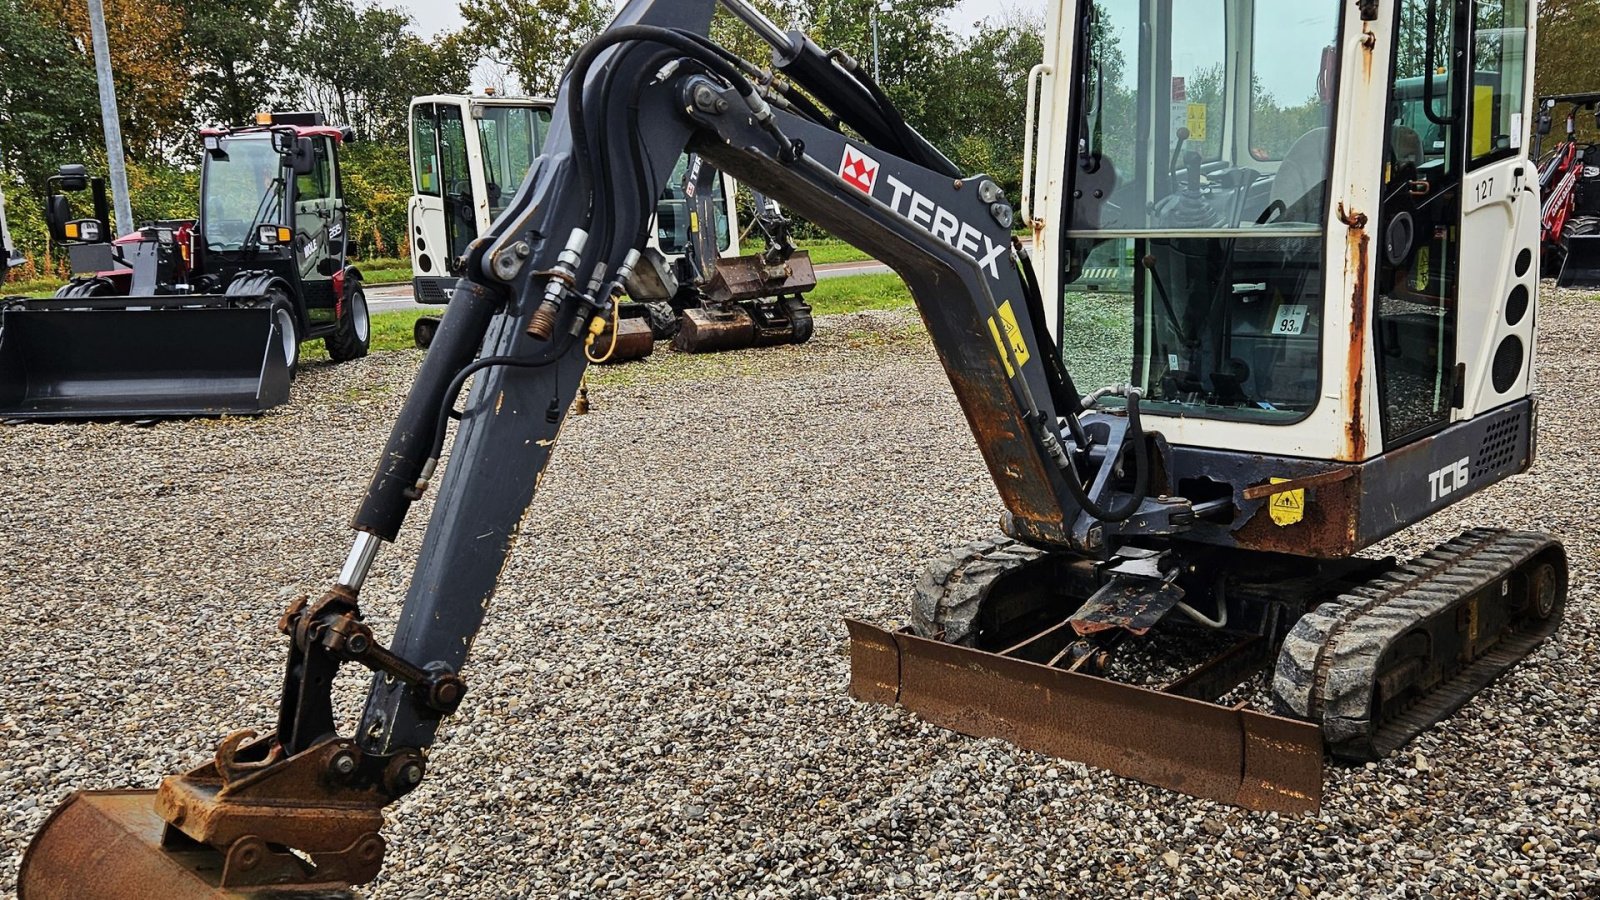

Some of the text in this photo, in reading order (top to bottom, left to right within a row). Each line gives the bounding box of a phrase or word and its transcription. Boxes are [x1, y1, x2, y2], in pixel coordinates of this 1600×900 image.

[1475, 177, 1494, 203] 127
[886, 174, 1007, 280] TEREX
[1280, 318, 1295, 332] 93
[1428, 456, 1470, 503] TC16
